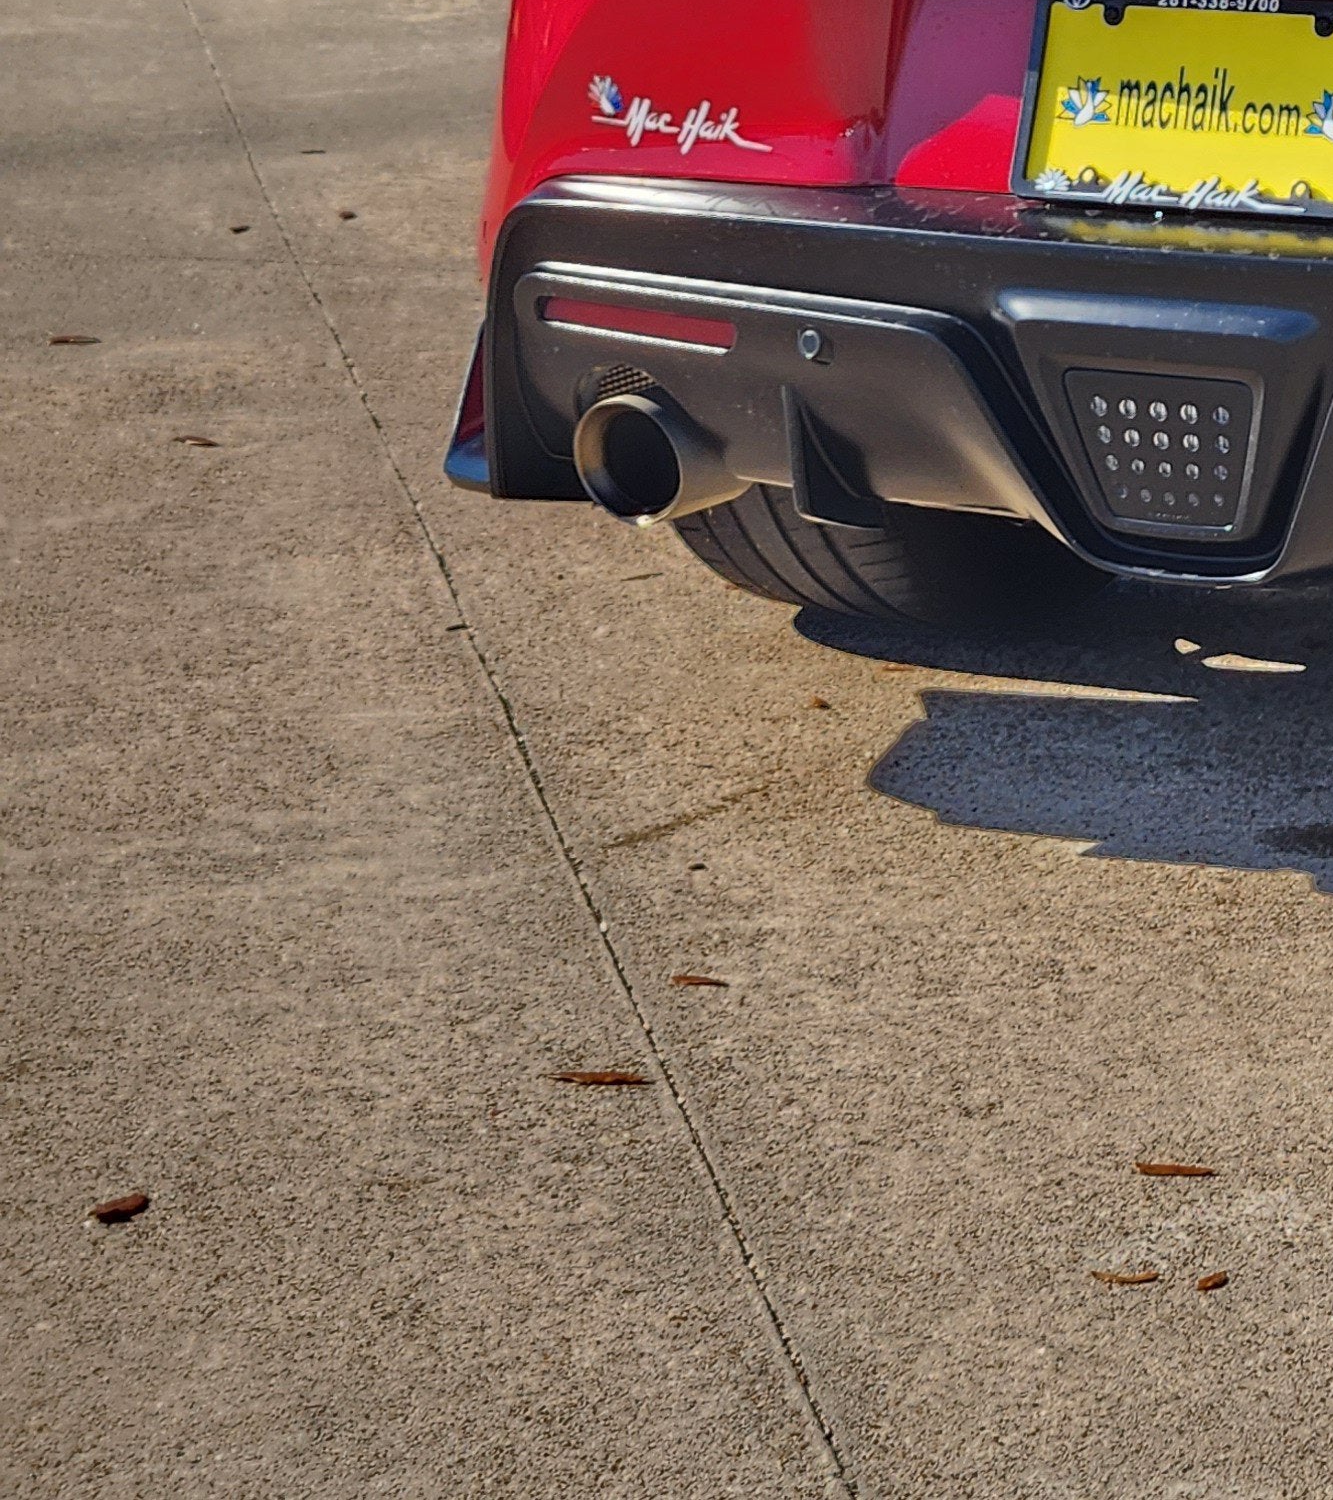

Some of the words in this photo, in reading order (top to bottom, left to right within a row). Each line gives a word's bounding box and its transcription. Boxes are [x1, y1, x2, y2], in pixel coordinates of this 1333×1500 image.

[626, 97, 680, 148] Mac
[677, 100, 773, 155] Haik
[1115, 66, 1301, 137] machaik.com
[1099, 170, 1179, 206] Mac
[1175, 177, 1306, 213] Haik
